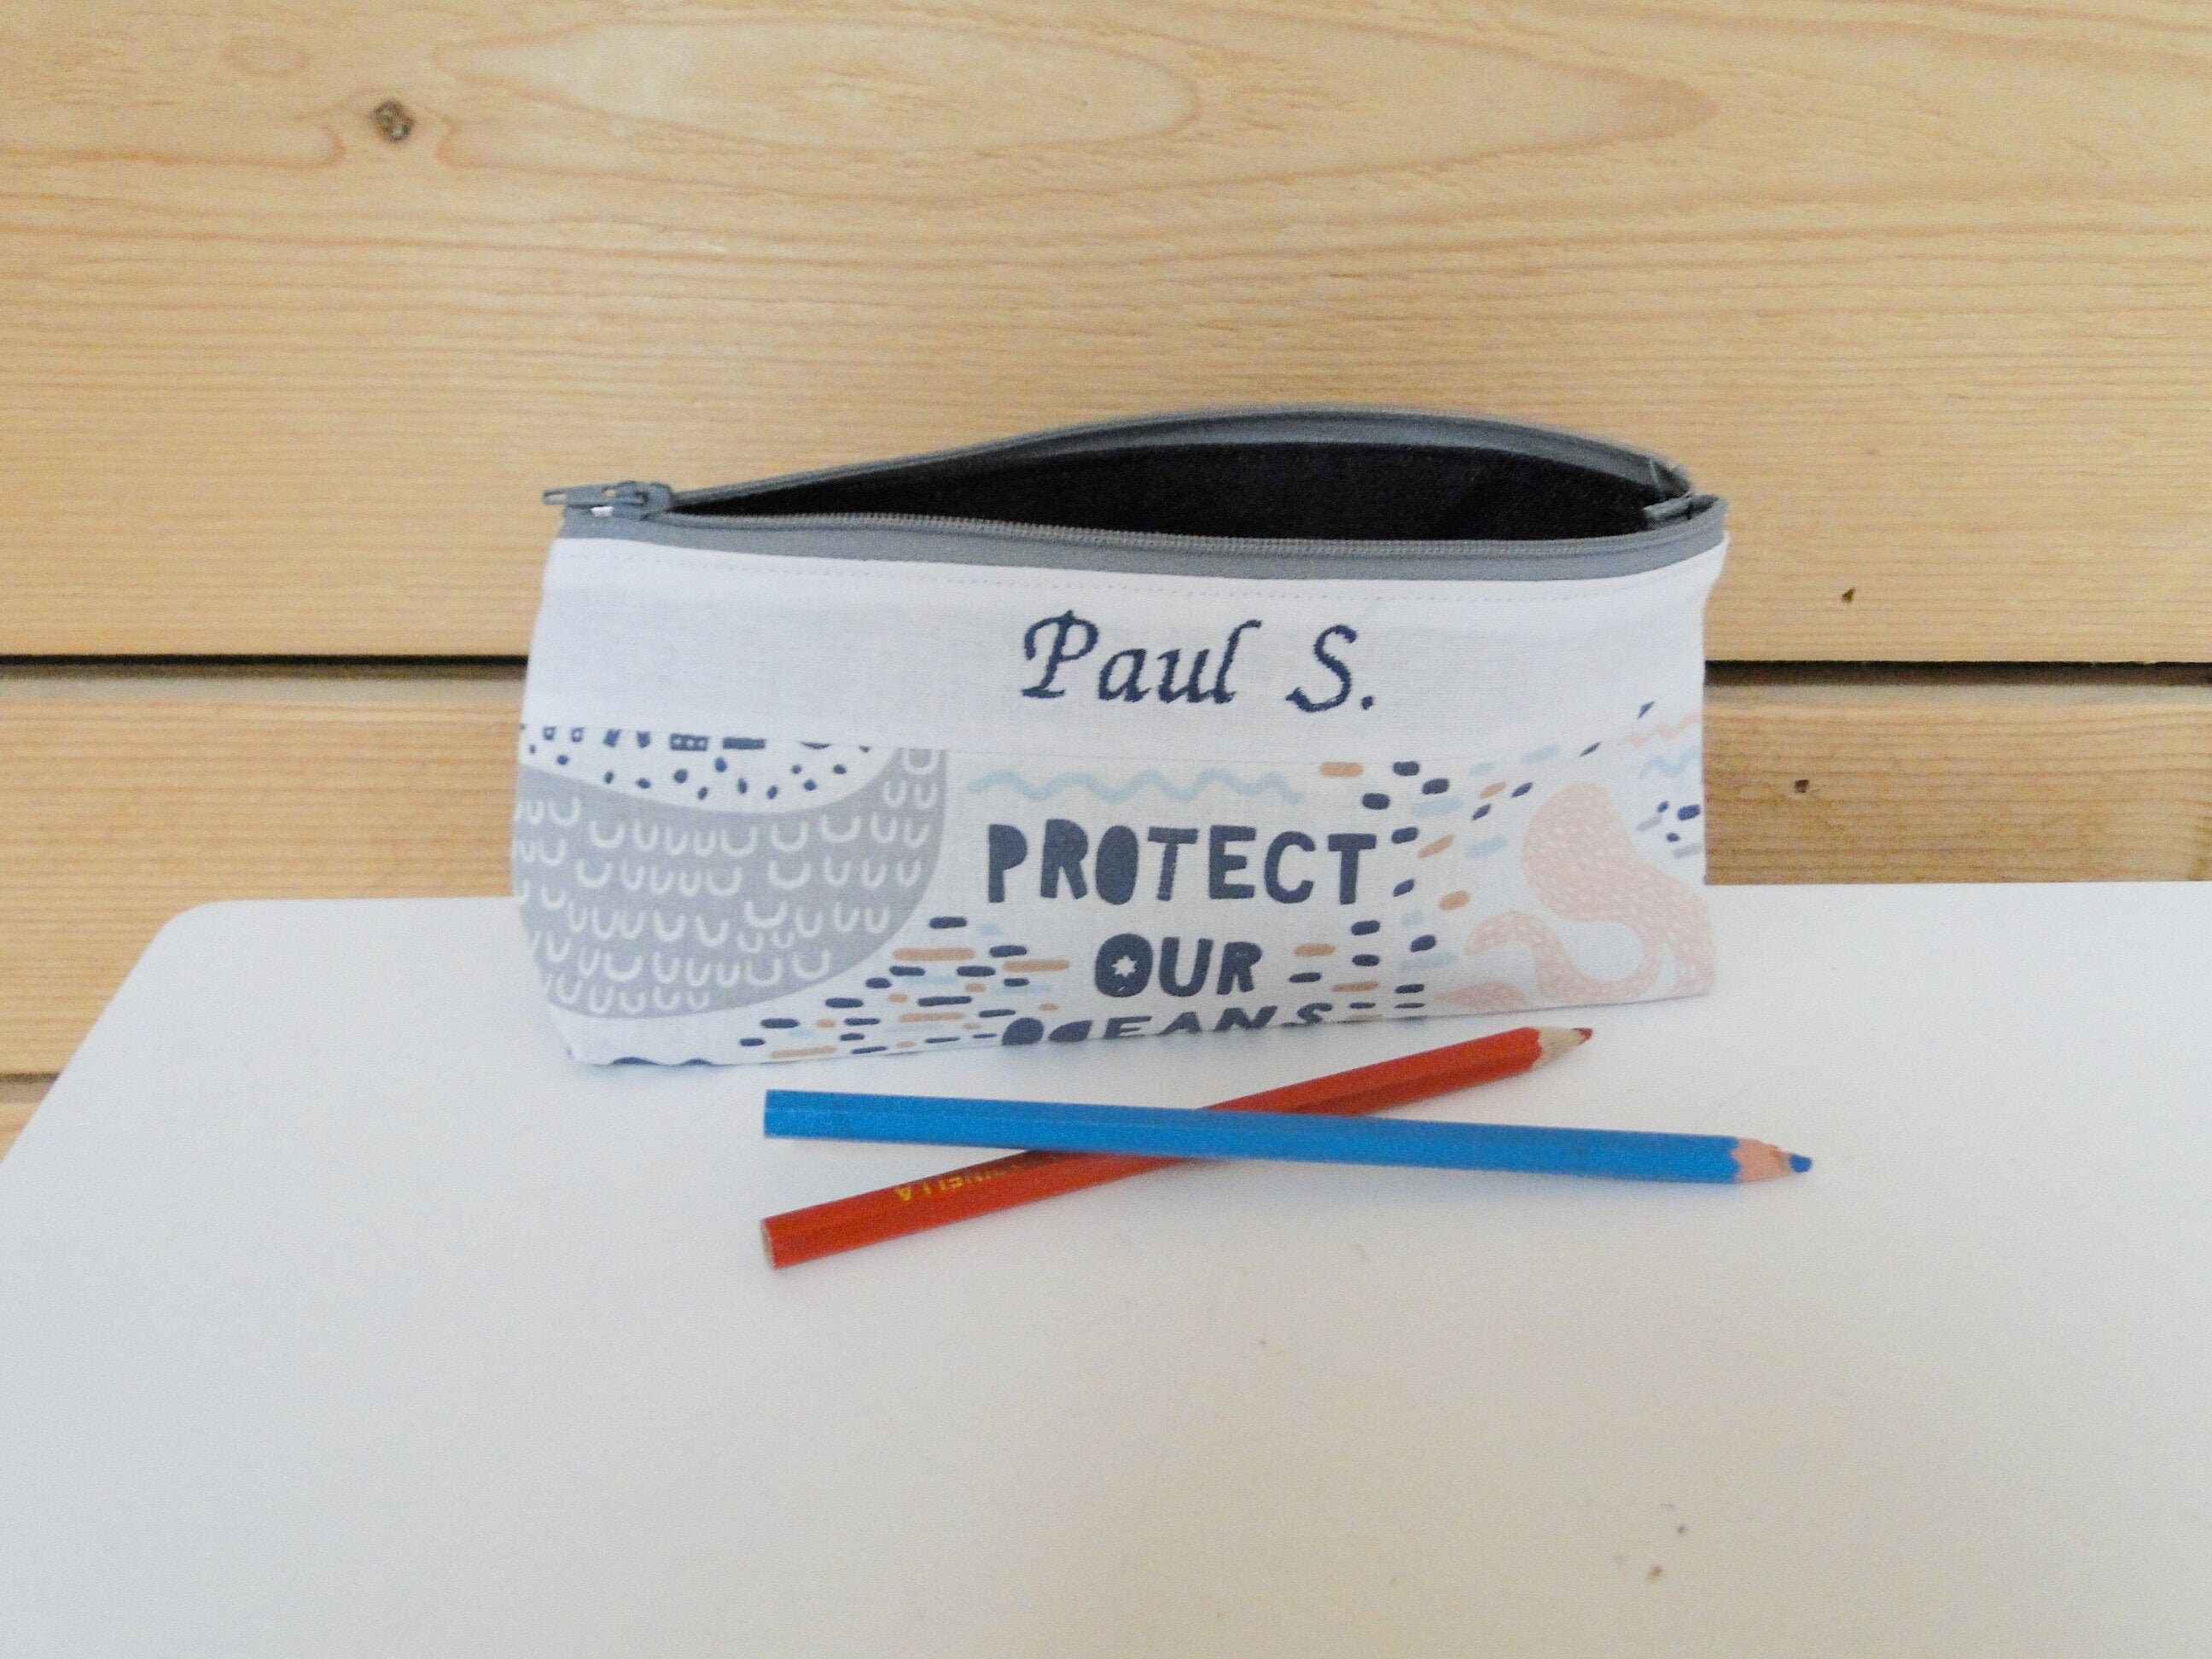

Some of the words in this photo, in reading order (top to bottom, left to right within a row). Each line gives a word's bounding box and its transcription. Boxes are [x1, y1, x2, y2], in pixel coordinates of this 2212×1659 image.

[1022, 609, 1262, 703] Paul
[1284, 624, 1374, 713] S.
[987, 818, 1377, 905] PROTECT
[1094, 933, 1263, 998] OUR
